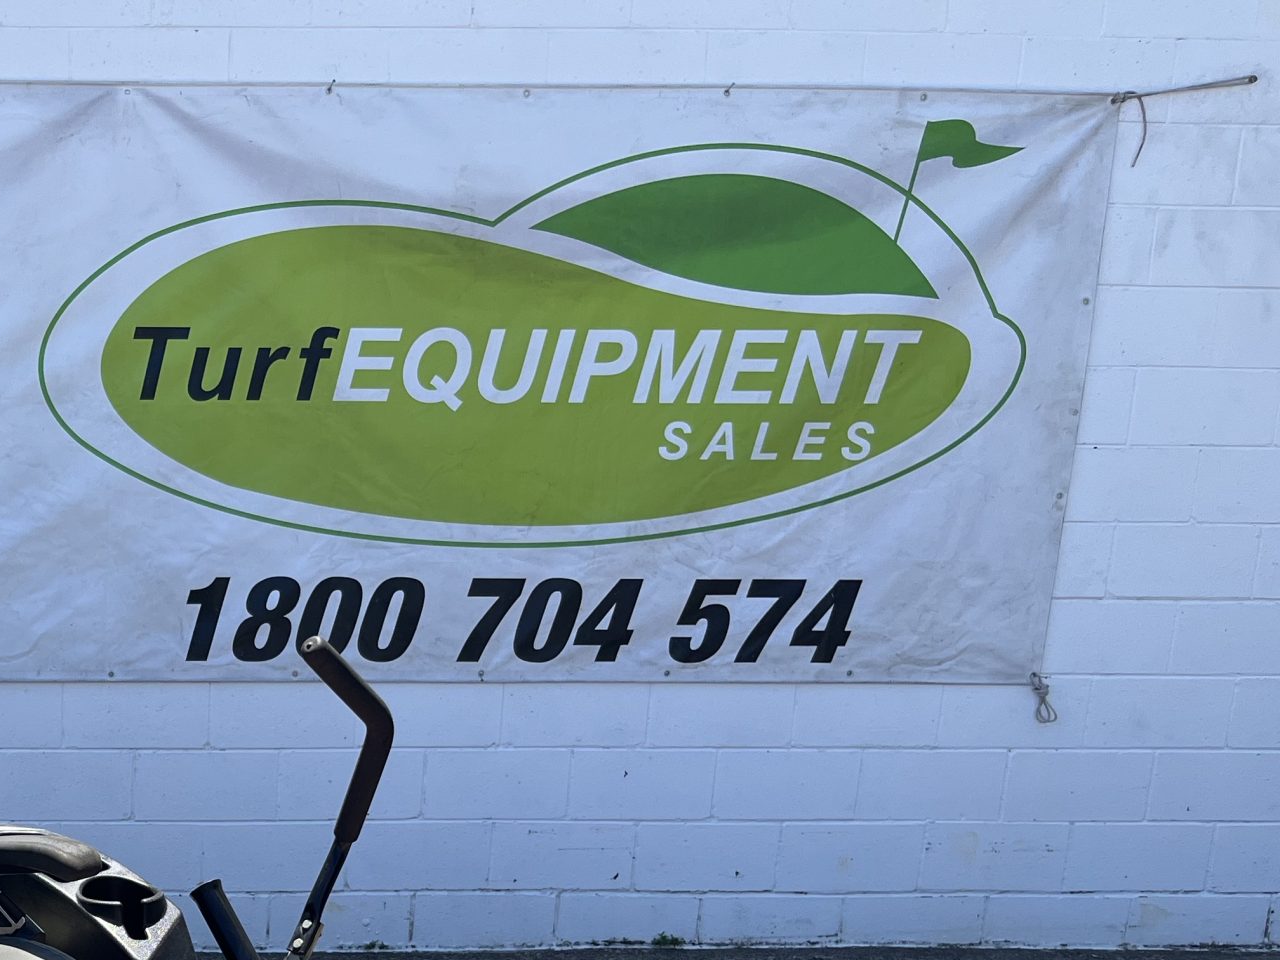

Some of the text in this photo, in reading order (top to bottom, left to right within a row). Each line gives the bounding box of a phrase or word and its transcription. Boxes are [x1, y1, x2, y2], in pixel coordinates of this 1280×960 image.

[657, 420, 877, 462] SALES
[184, 575, 864, 664] 1800 704 574
